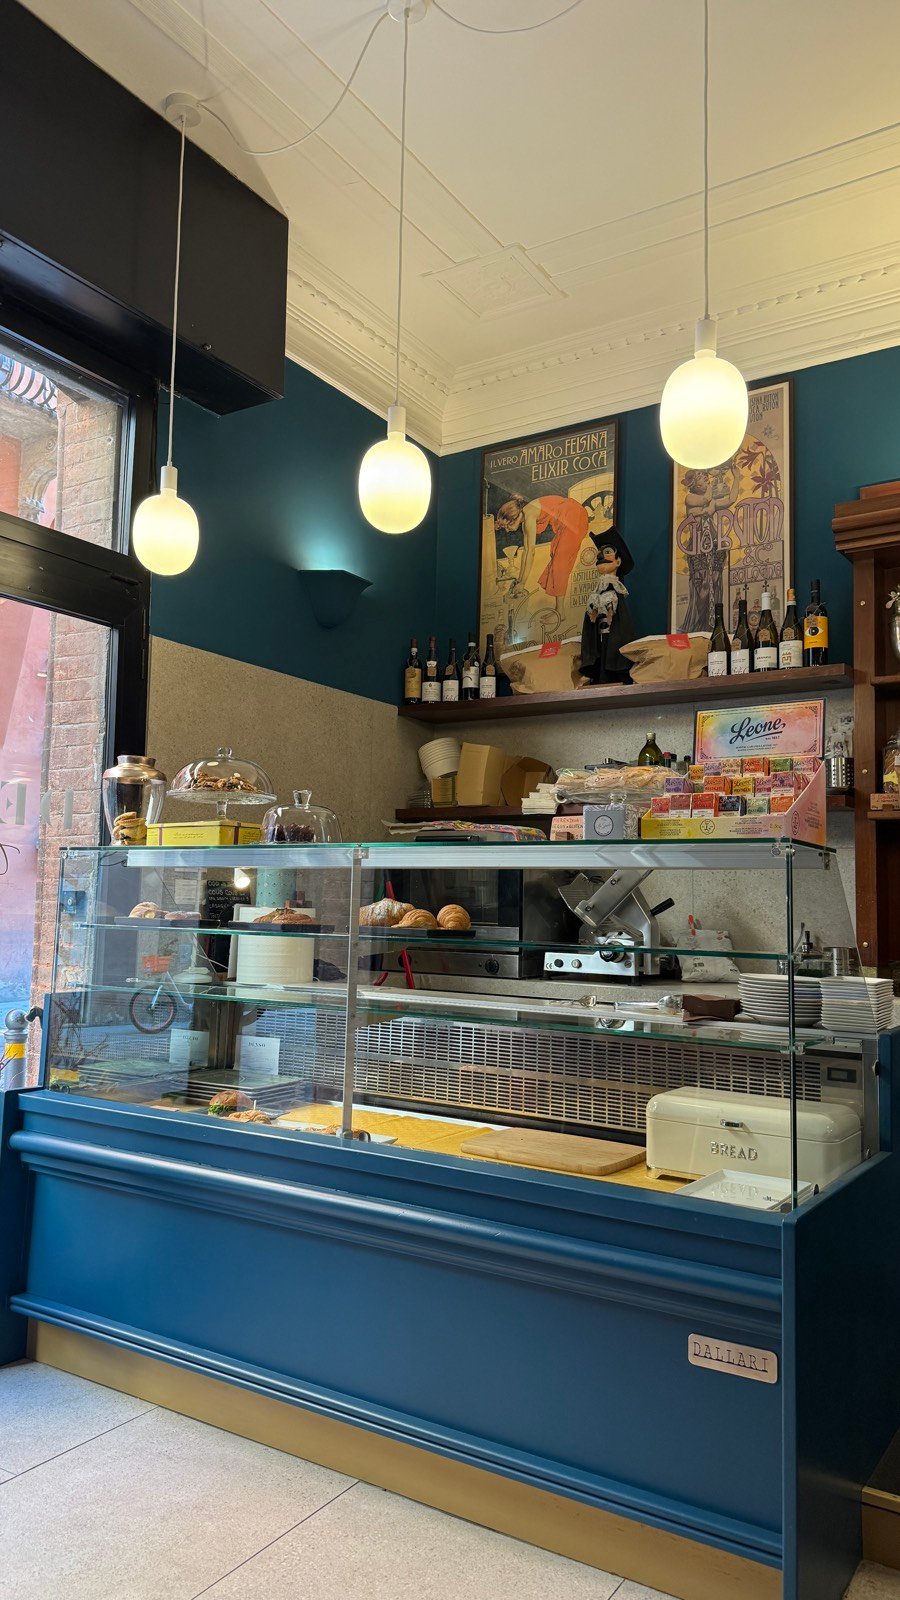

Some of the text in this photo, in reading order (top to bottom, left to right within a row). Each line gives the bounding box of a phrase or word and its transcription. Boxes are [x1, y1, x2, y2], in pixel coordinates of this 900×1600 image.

[520, 443, 563, 466] AMARO
[564, 430, 608, 456] FELSINA
[531, 450, 608, 481] ELIXIR COCA
[729, 717, 787, 744] Leone
[710, 1141, 759, 1161] BREAD
[693, 1341, 769, 1373] DALLARI
